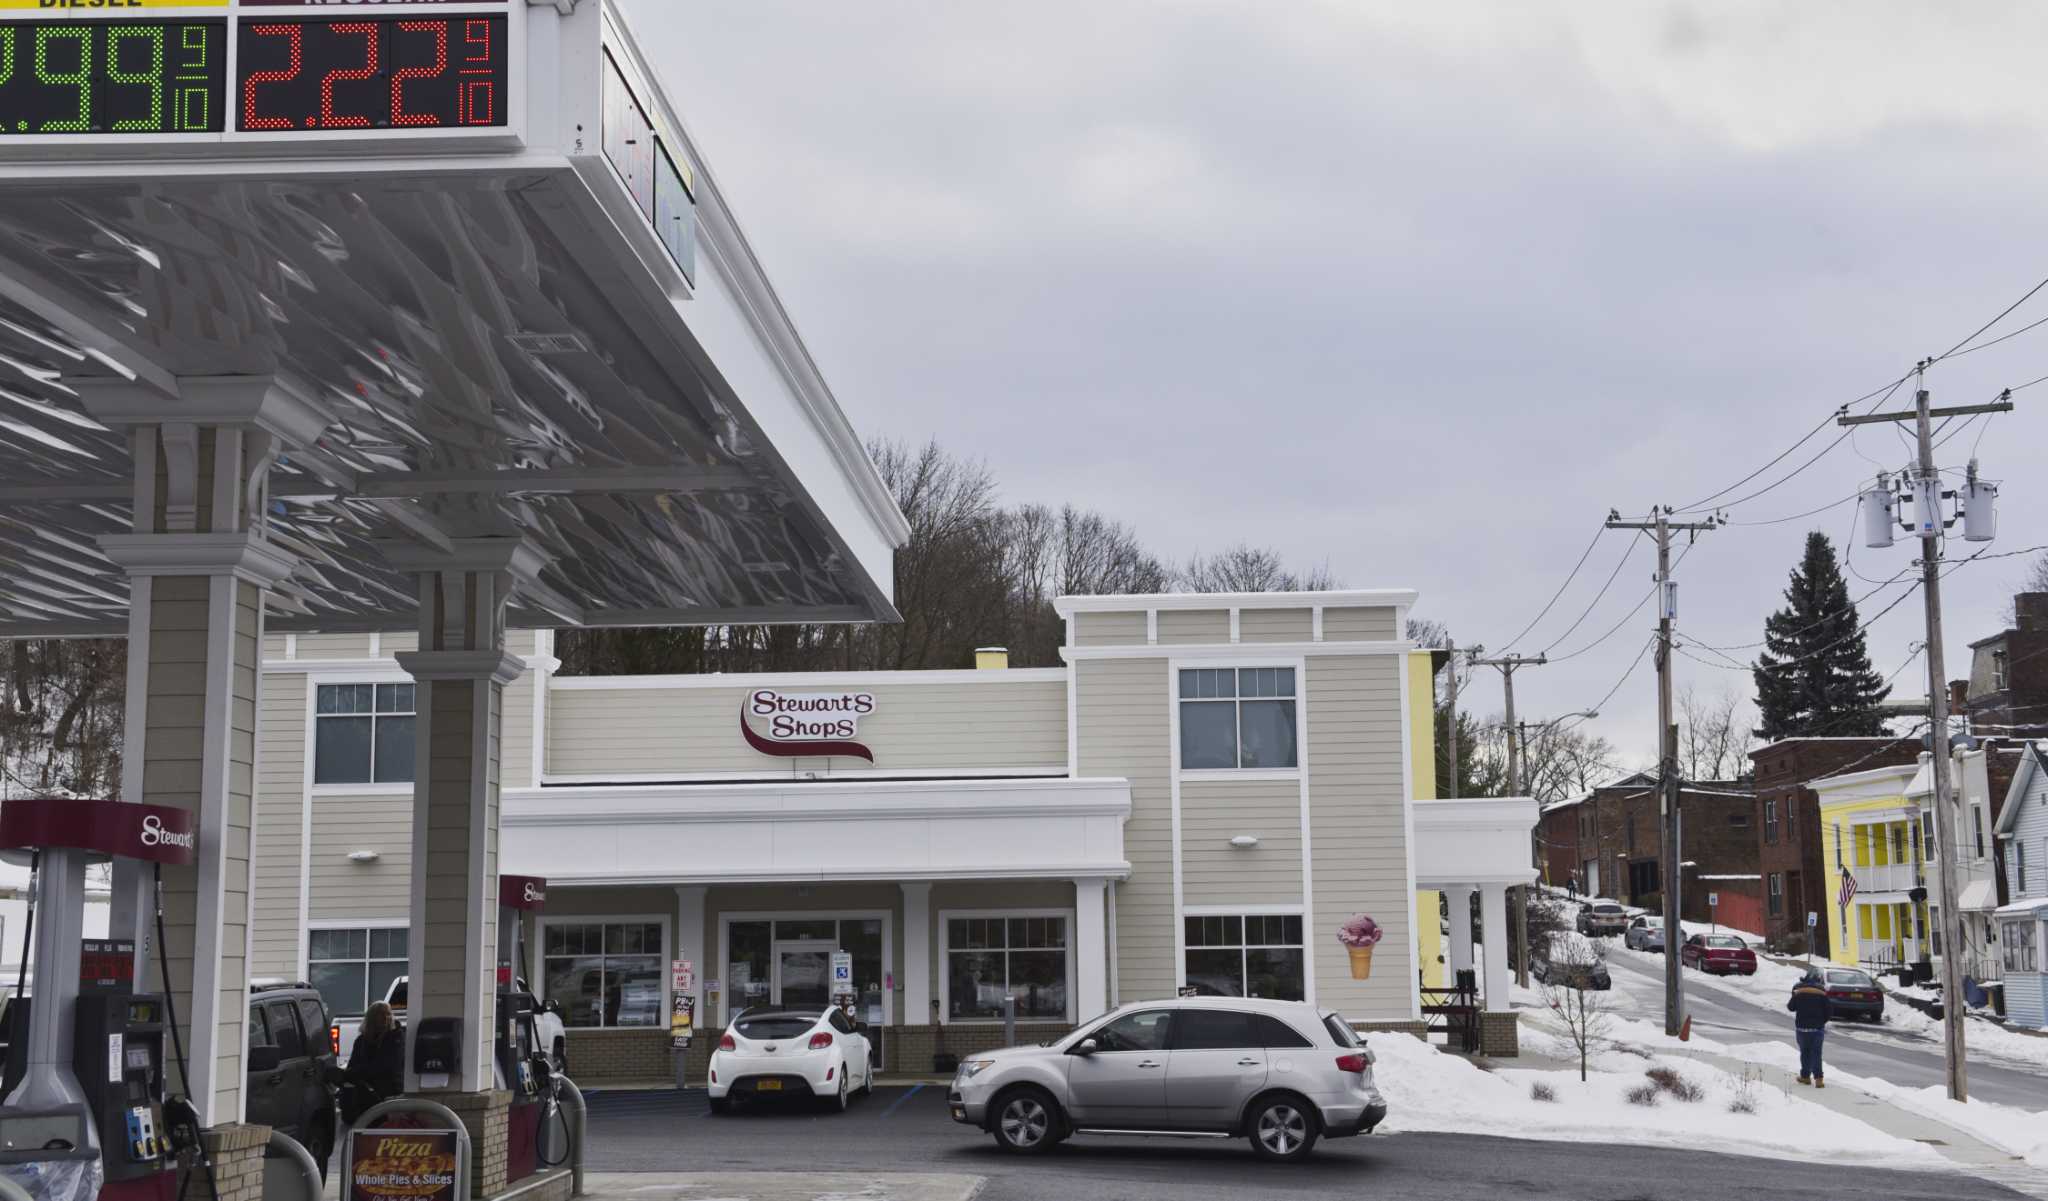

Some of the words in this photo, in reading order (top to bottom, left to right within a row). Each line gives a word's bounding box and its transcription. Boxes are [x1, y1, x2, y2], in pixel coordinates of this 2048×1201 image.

[244, 20, 448, 129] 2.22
[771, 714, 855, 738] Shops
[376, 1137, 433, 1157] Pizza
[355, 1174, 386, 1185] Whole
[389, 1174, 411, 1185] Pies
[413, 1174, 420, 1185] &
[423, 1174, 453, 1185] Slices
